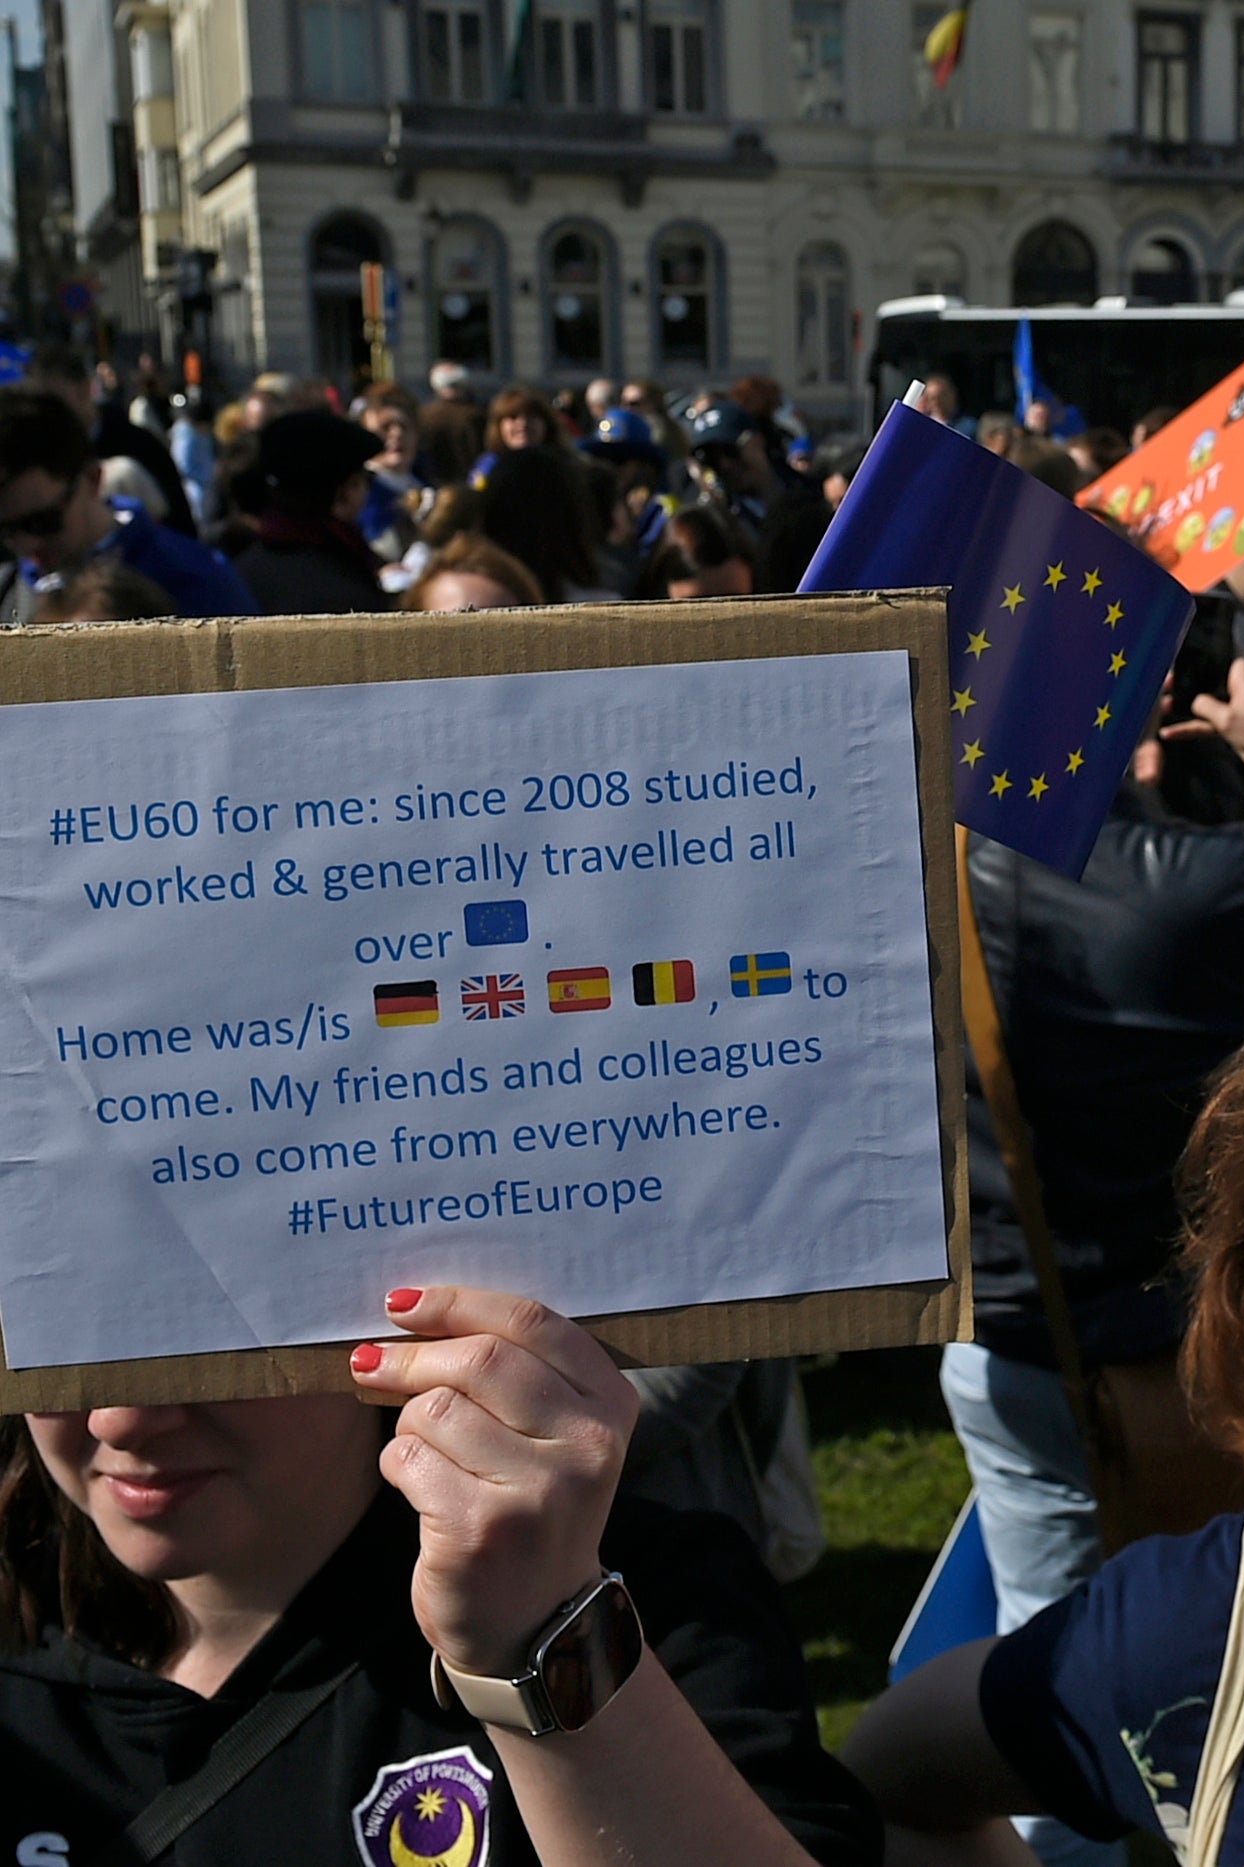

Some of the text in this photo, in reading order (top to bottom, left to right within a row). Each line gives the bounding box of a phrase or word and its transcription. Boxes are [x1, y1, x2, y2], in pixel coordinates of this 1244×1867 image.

[49, 756, 817, 846] #EU60 for me: since 2008 studied,
[83, 820, 795, 910] worked & generally travelled all
[354, 930, 453, 964] over
[56, 968, 848, 1062] Home was/is to
[96, 1037, 822, 1124] come. My friends and colleagues
[151, 1101, 780, 1184] also come from everywhere.
[287, 1175, 663, 1237] #FutureofEurope
[364, 1773, 414, 1837] UNIVERSITY
[413, 1765, 431, 1783] OF
